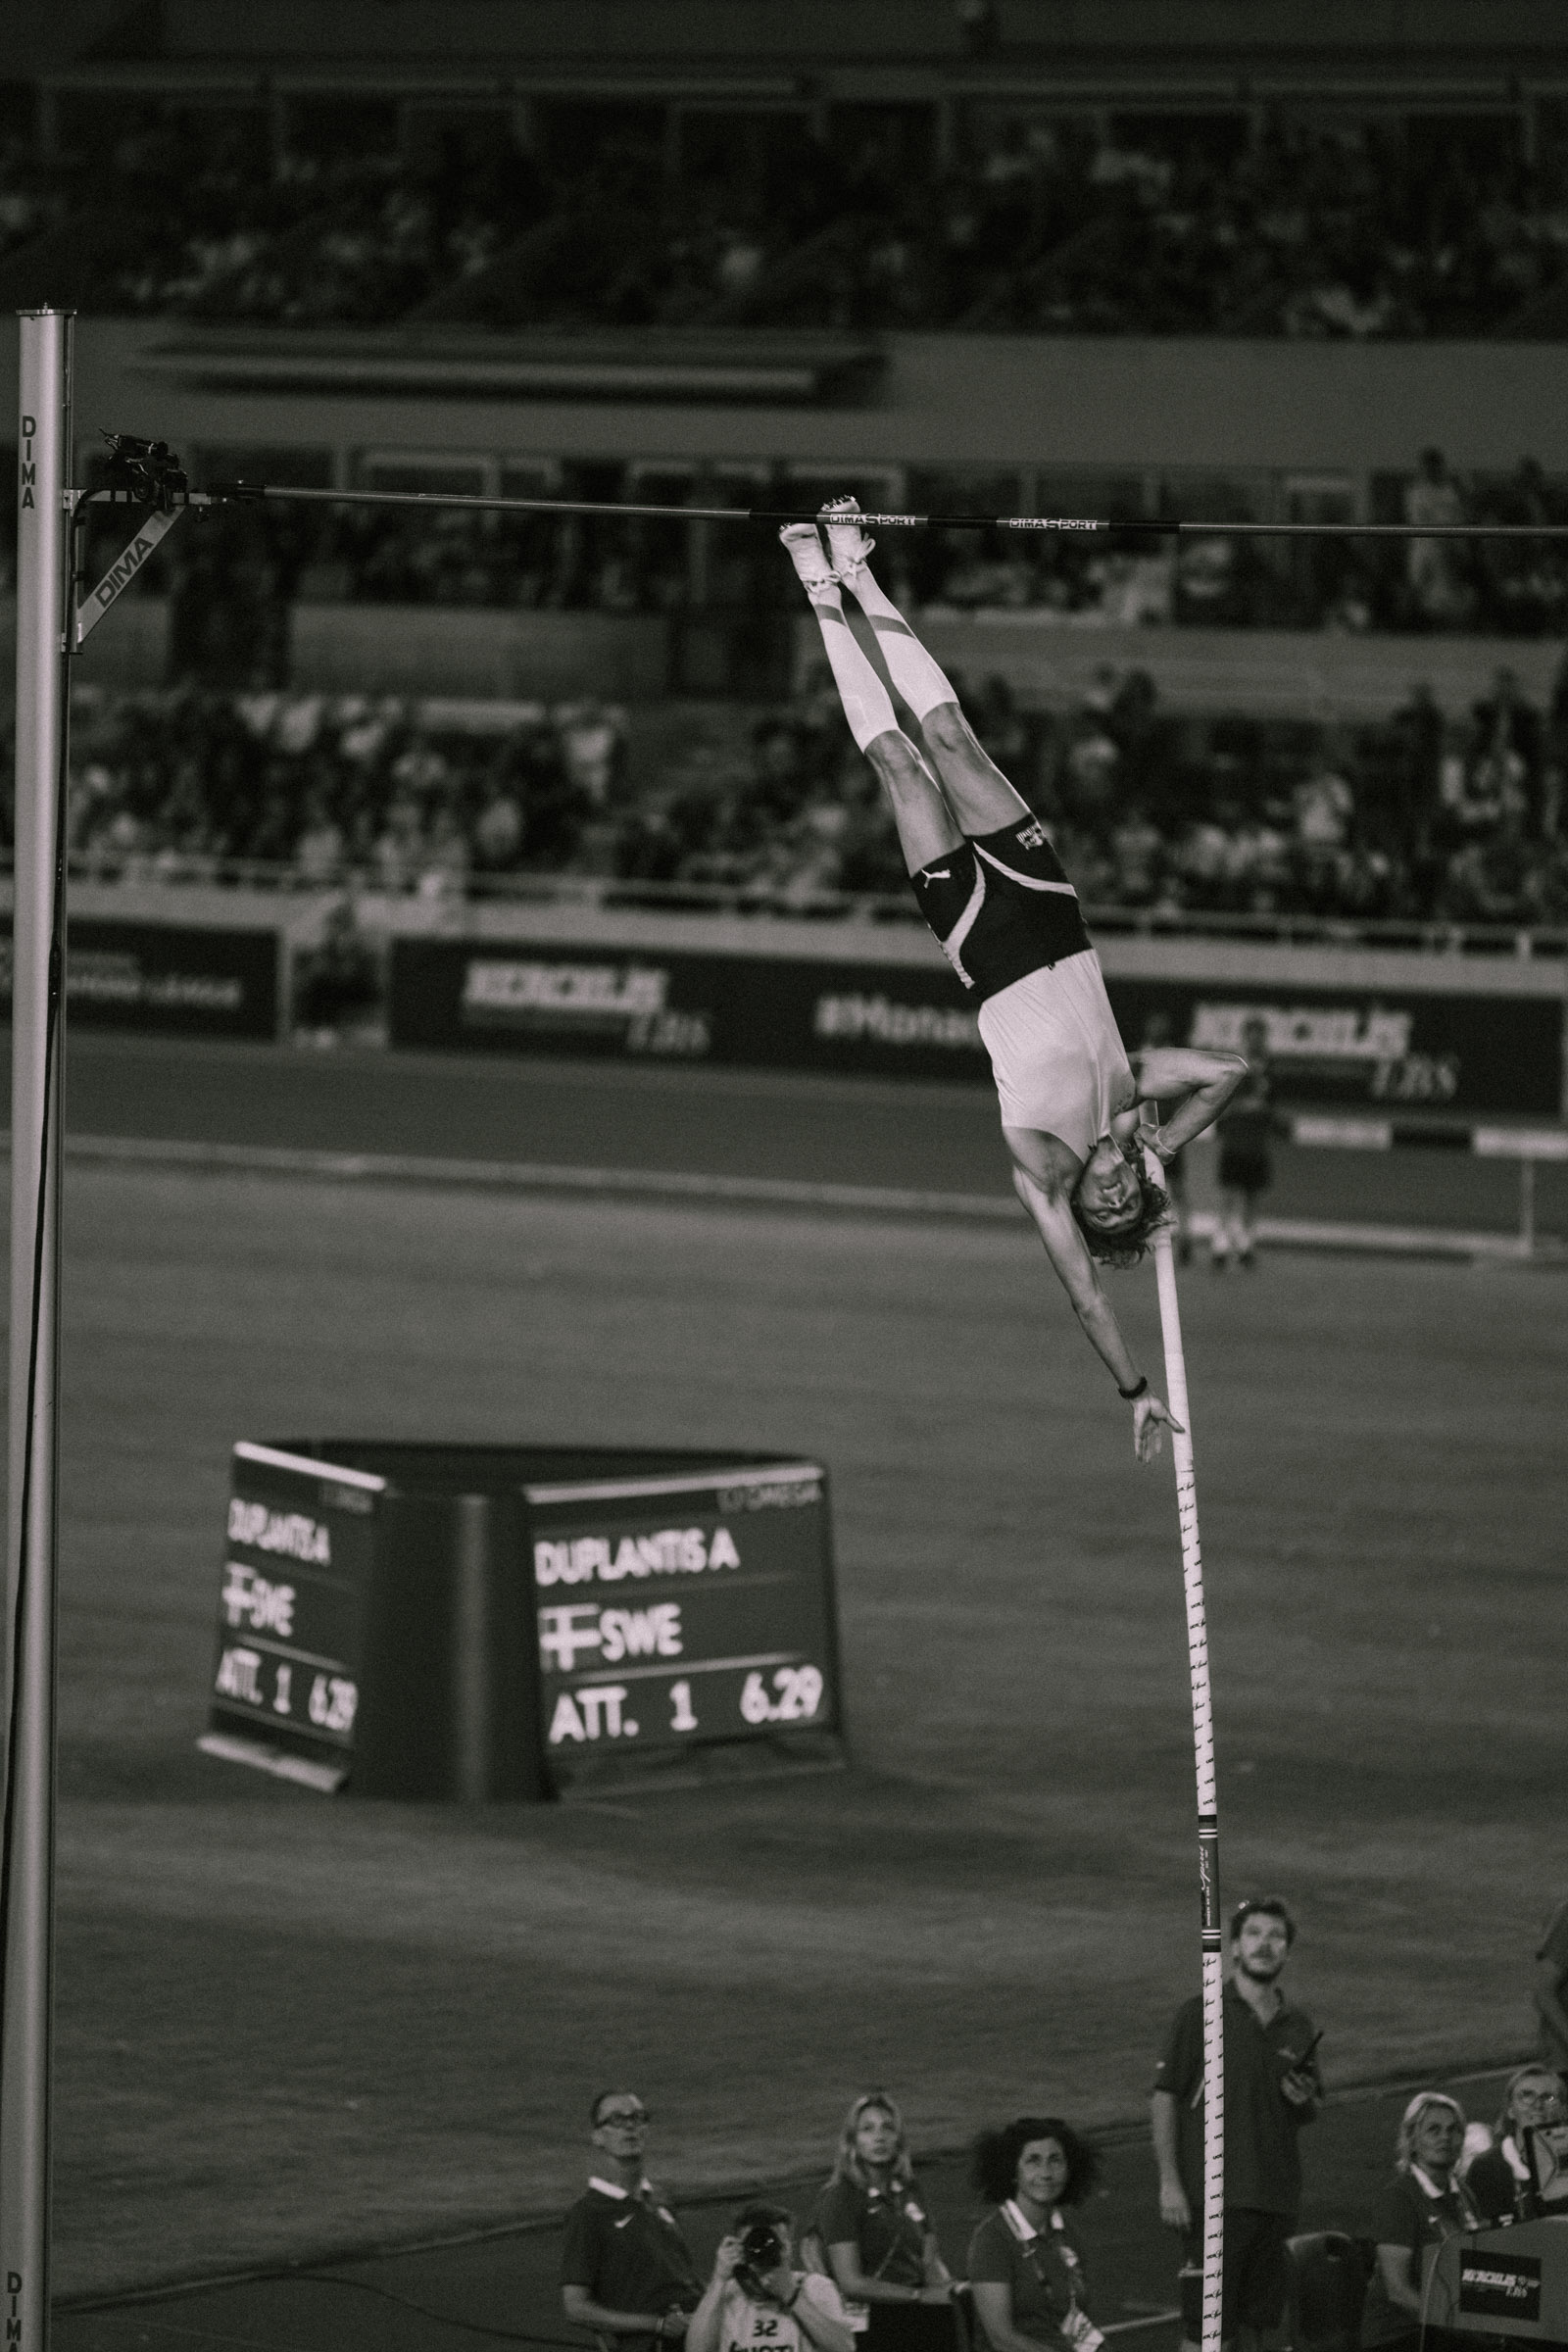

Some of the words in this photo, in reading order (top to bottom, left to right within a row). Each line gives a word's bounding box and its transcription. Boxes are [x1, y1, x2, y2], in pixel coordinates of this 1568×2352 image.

[22, 415, 36, 509] DIMA
[94, 537, 154, 609] DIMA
[534, 1528, 708, 1587] DUPLANTIS
[709, 1527, 742, 1571] A
[599, 1602, 684, 1661] SWE
[272, 1663, 291, 1714] 1
[549, 1685, 639, 1744] ATT.
[670, 1680, 698, 1731] 1
[740, 1665, 823, 1725] 6.29
[753, 2319, 778, 2337] 32
